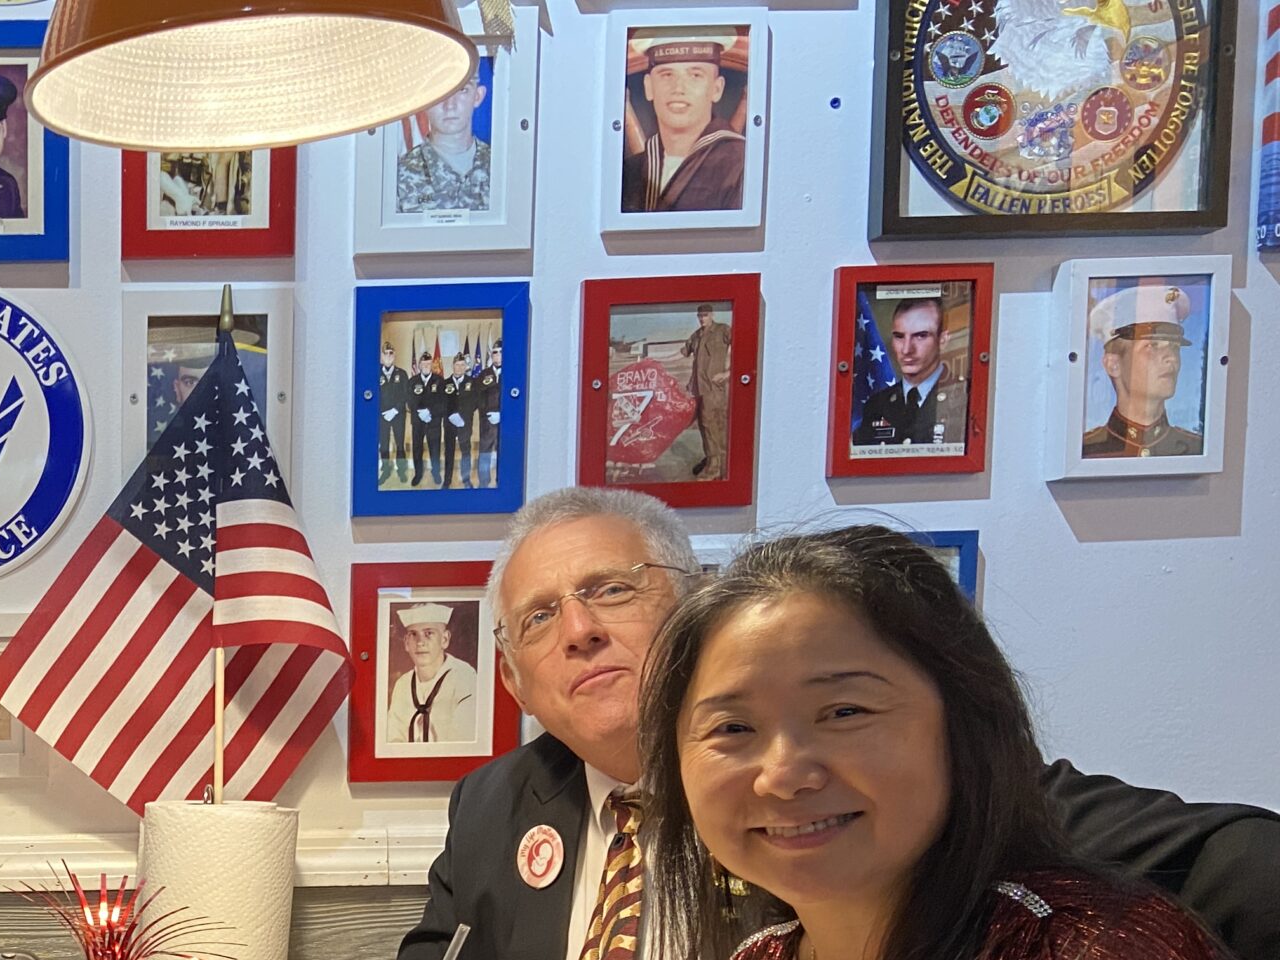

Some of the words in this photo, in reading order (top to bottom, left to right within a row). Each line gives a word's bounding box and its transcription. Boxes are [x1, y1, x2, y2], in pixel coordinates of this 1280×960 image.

[1182, 52, 1201, 77] BE
[935, 95, 1012, 178] DEFENDERS
[1019, 168, 1040, 184] OF
[1046, 166, 1085, 185] OUR
[1091, 100, 1160, 174] FREEDOM
[1127, 79, 1196, 185] FORGOTTEN
[919, 142, 955, 180] THE
[970, 183, 1032, 213] FALLEN
[1036, 188, 1106, 213] HEROES
[617, 368, 657, 385] BRAVO
